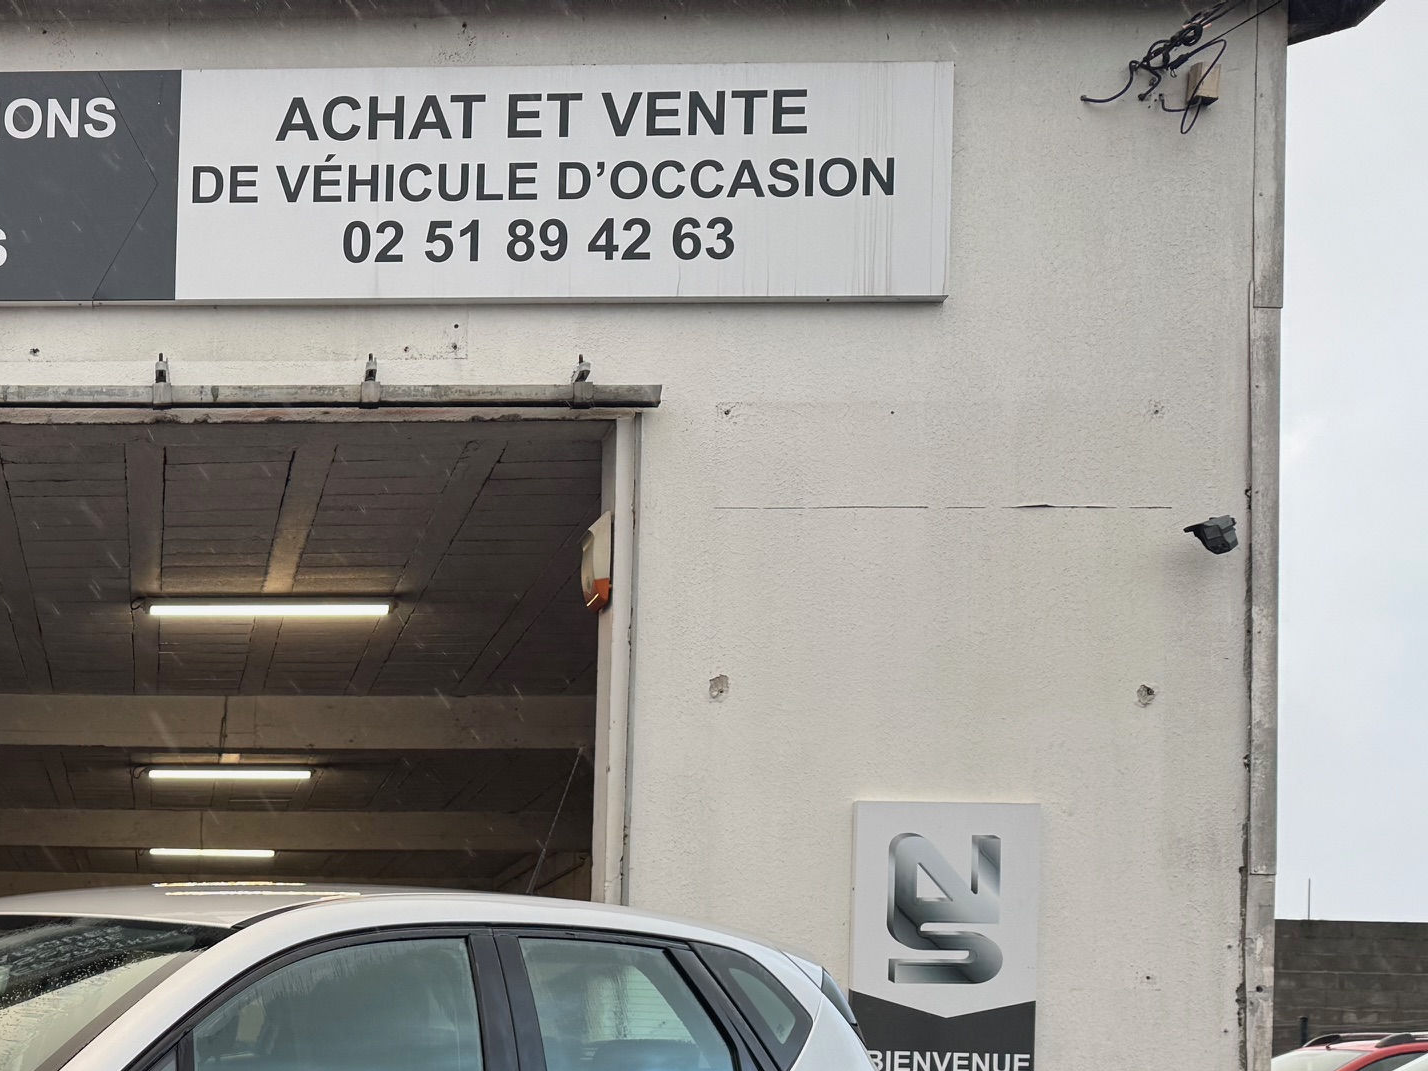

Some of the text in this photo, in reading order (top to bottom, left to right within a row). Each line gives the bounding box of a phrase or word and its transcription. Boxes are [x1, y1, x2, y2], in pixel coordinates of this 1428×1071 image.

[275, 88, 809, 142] ACHAT ET VENTE
[192, 165, 260, 204] DE
[275, 154, 539, 203] VÉHICULE
[343, 216, 735, 264] 02 51 89 42 63
